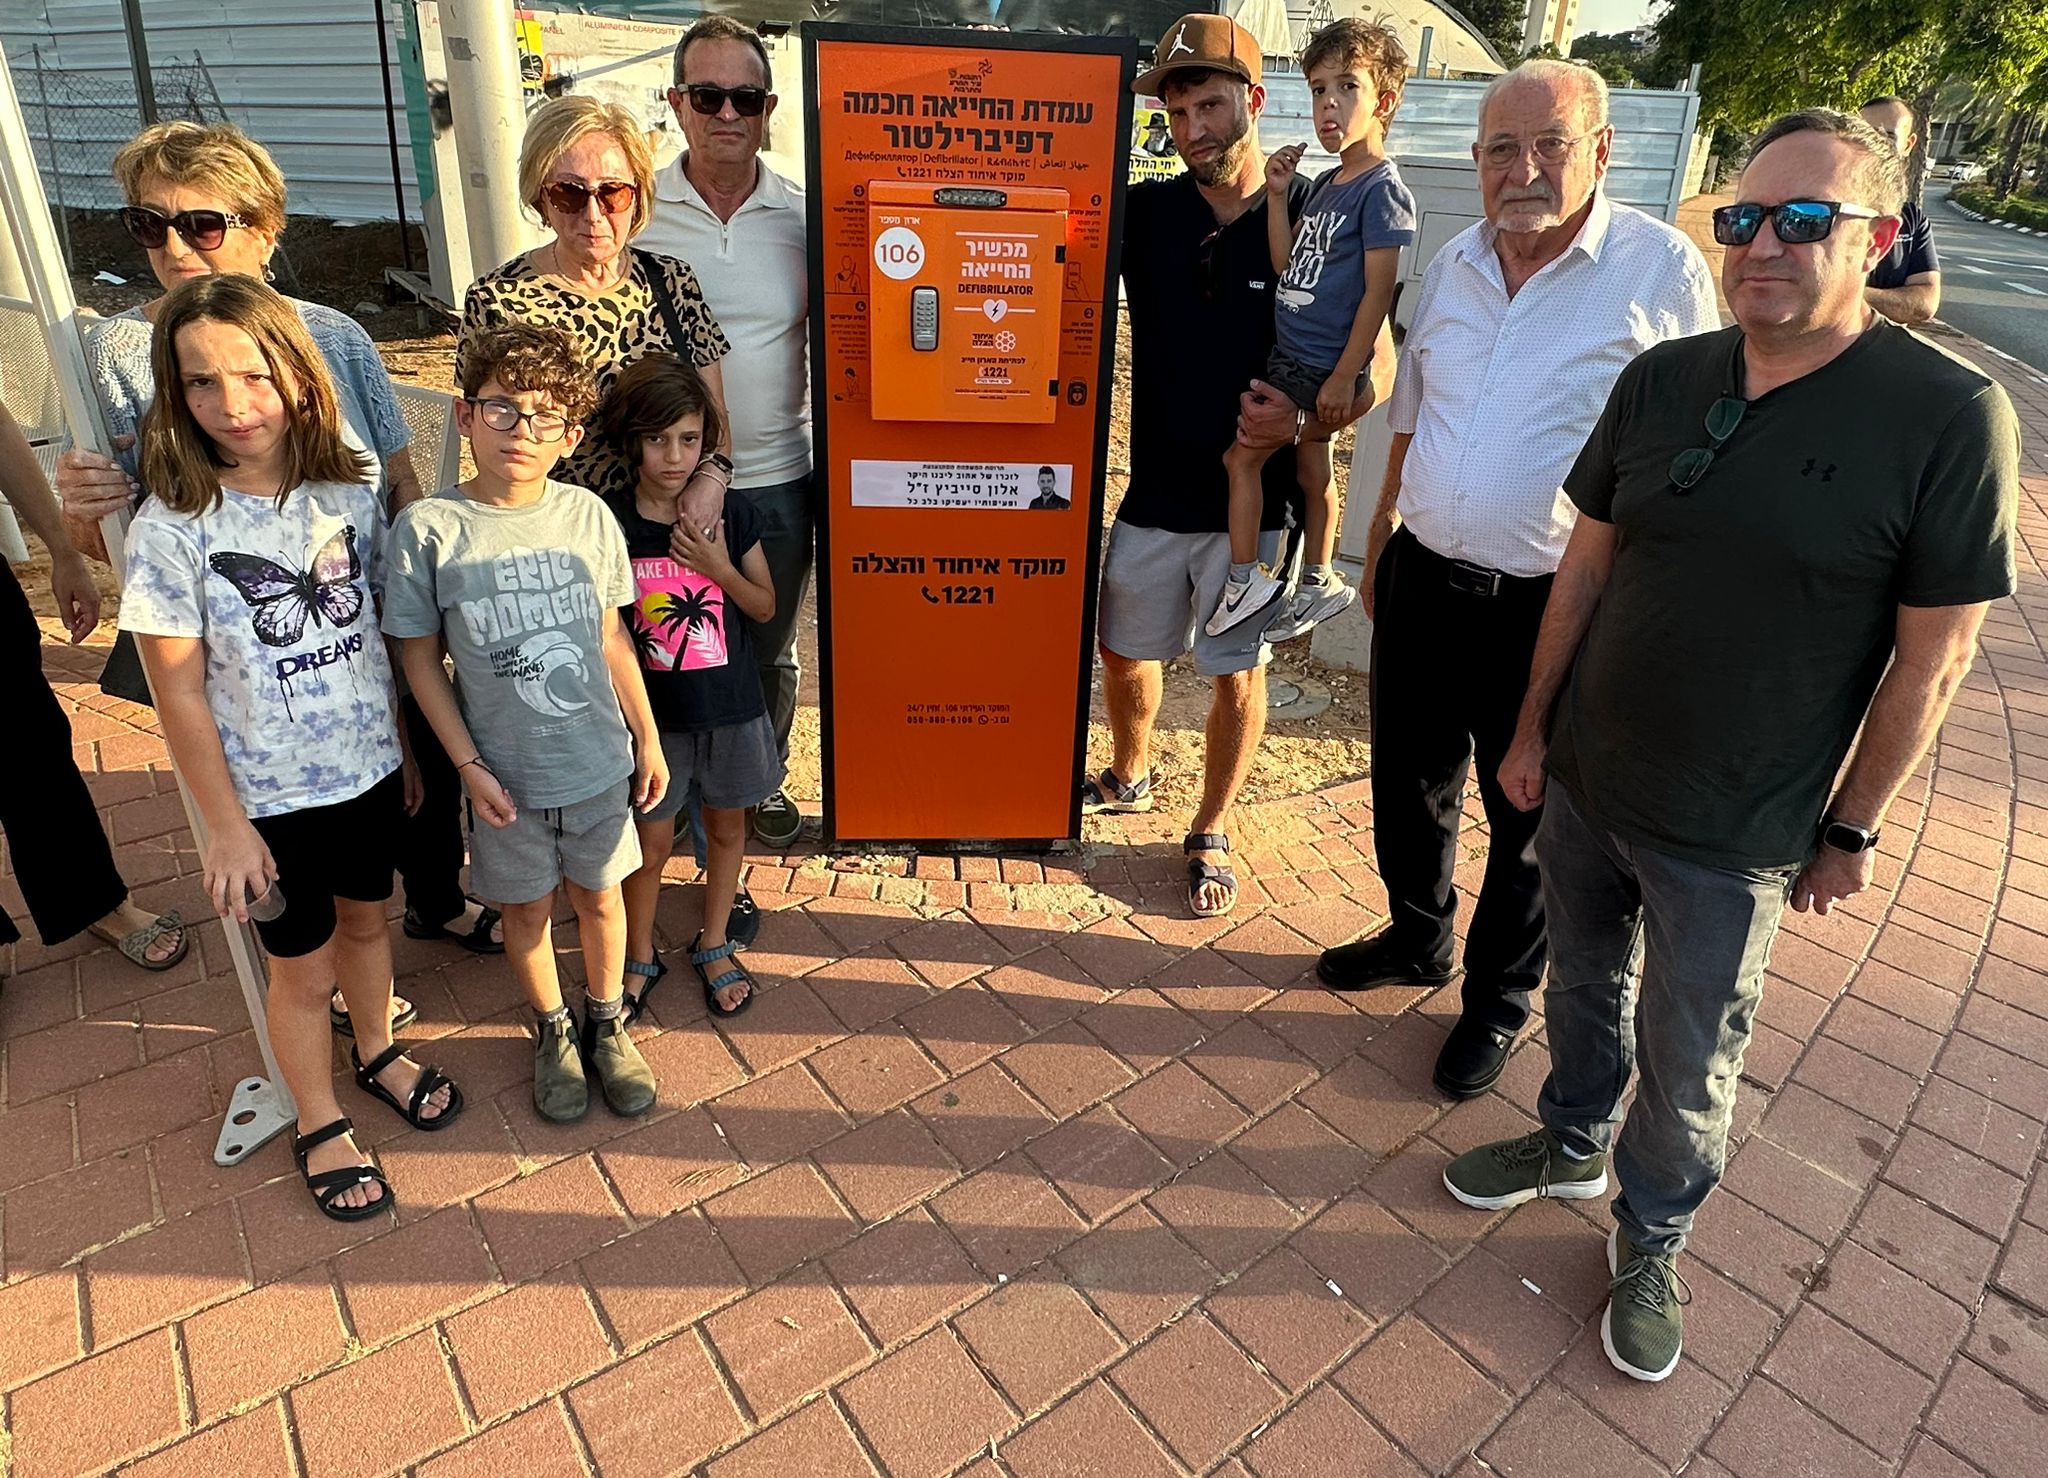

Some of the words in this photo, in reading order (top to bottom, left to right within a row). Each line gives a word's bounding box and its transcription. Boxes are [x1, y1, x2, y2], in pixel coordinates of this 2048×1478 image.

[633, 25, 676, 35] COMPOSITE
[843, 91, 914, 116] חכמה
[922, 95, 1013, 121] החייאה
[1021, 99, 1093, 124] עמדת
[883, 120, 1054, 155] דפיברילטור
[845, 150, 918, 164] Дефибриллятор
[924, 154, 978, 165] Defibrillator
[1129, 158, 1157, 170] המלך
[1161, 160, 1176, 170] יחי
[907, 167, 931, 178] 1221
[967, 170, 997, 180] איחוד
[903, 215, 921, 225] ארון
[880, 244, 920, 263] 106
[965, 240, 1028, 258] מכשיר
[961, 261, 1031, 279] החייאה
[958, 283, 1034, 295] DEFIBRILLATOR
[983, 367, 1008, 378] 1221
[931, 471, 953, 479] ליבנו
[980, 472, 992, 480] של
[996, 473, 1019, 481] לזכרו
[907, 481, 929, 493] ז"ל
[935, 484, 981, 496] סייביץ
[988, 483, 1019, 497] אלון
[907, 497, 918, 505] כל
[852, 552, 925, 574] והצלה
[932, 557, 1001, 574] איחוד
[1007, 558, 1066, 579] מוקד
[941, 586, 994, 604] 1221
[276, 633, 362, 680] DREAMS
[490, 645, 521, 662] HOME
[511, 660, 545, 678] WAVES
